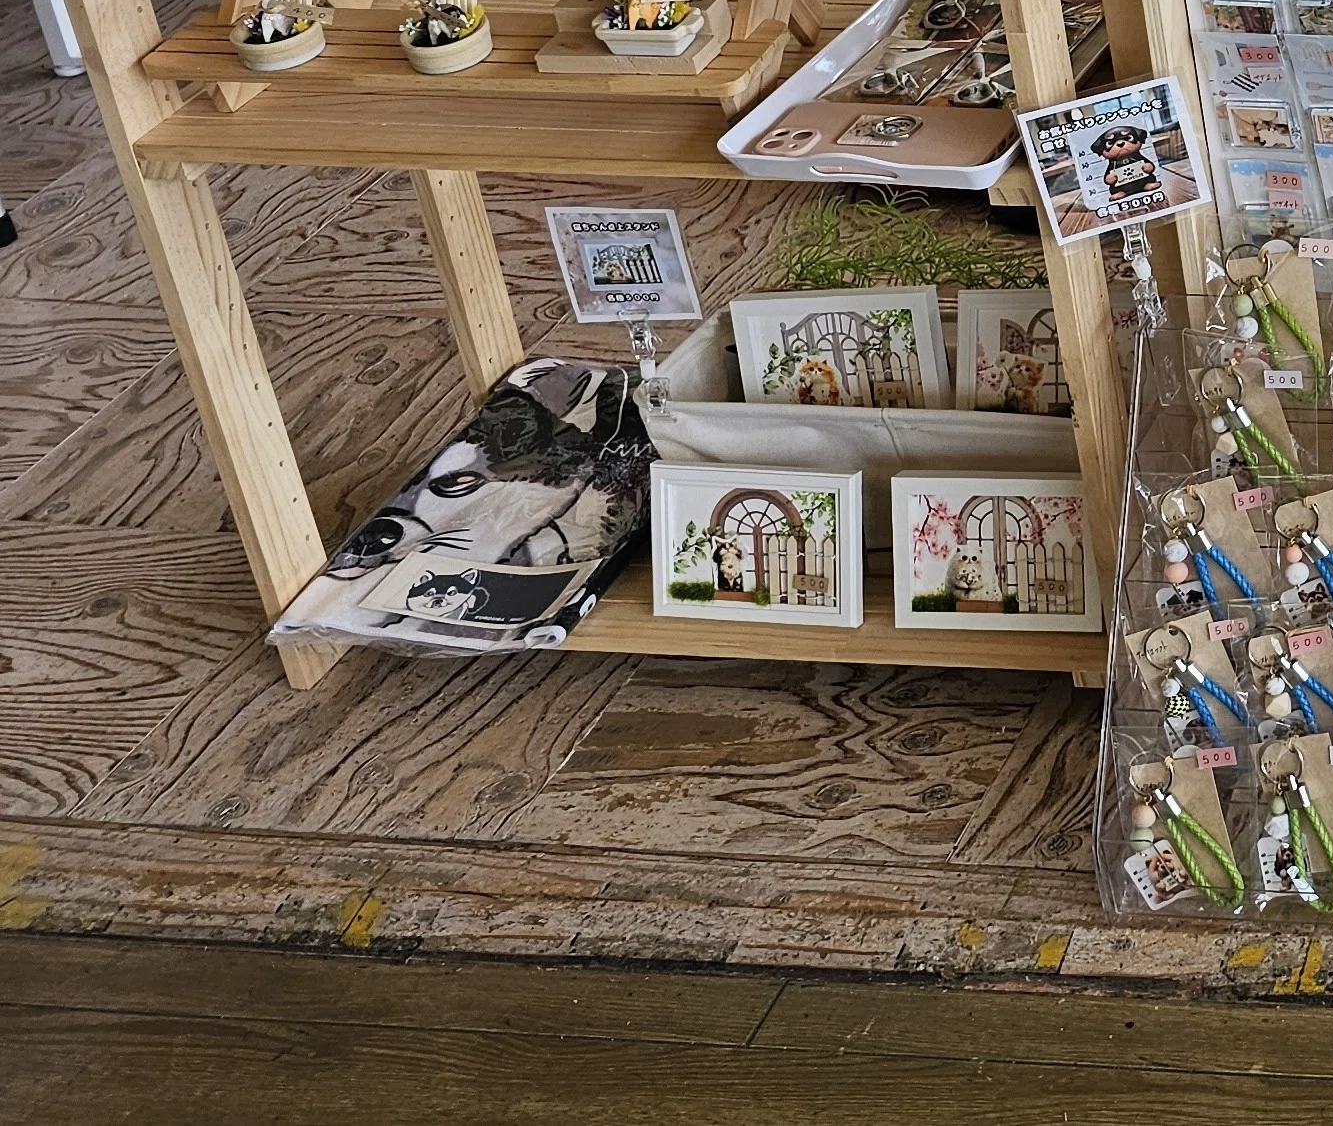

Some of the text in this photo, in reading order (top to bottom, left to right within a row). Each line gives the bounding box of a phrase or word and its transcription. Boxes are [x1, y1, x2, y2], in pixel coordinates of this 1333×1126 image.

[1245, 51, 1274, 61] 300
[1272, 175, 1298, 187] 300
[1301, 243, 1330, 253] 500
[1268, 375, 1296, 385] 500
[1237, 493, 1267, 506] 500
[1214, 623, 1245, 635] 500
[1292, 636, 1323, 650] 500
[1203, 752, 1231, 764] 500
